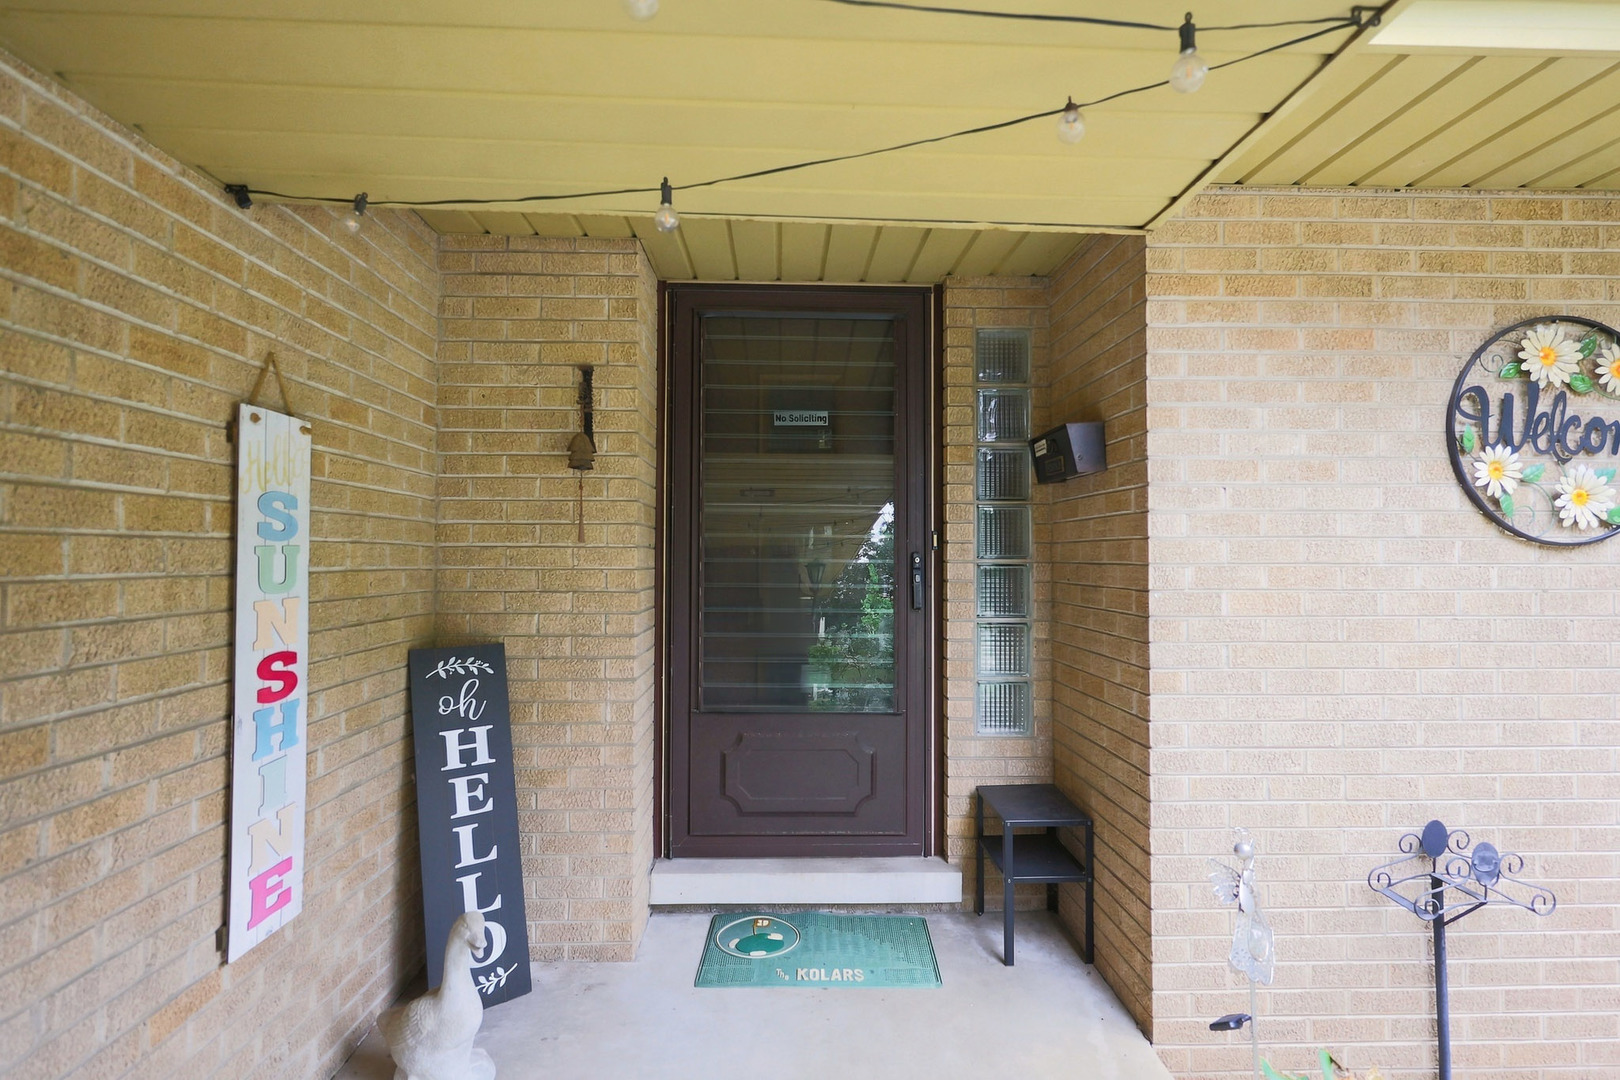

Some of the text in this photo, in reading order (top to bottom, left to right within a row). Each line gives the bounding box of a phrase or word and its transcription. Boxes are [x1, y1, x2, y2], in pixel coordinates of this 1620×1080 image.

[775, 414, 827, 425] No Soliciting
[240, 431, 308, 494] Hello
[247, 490, 300, 932] SUNSHINE
[438, 678, 487, 721] oh
[776, 967, 864, 982] The KOLARS
